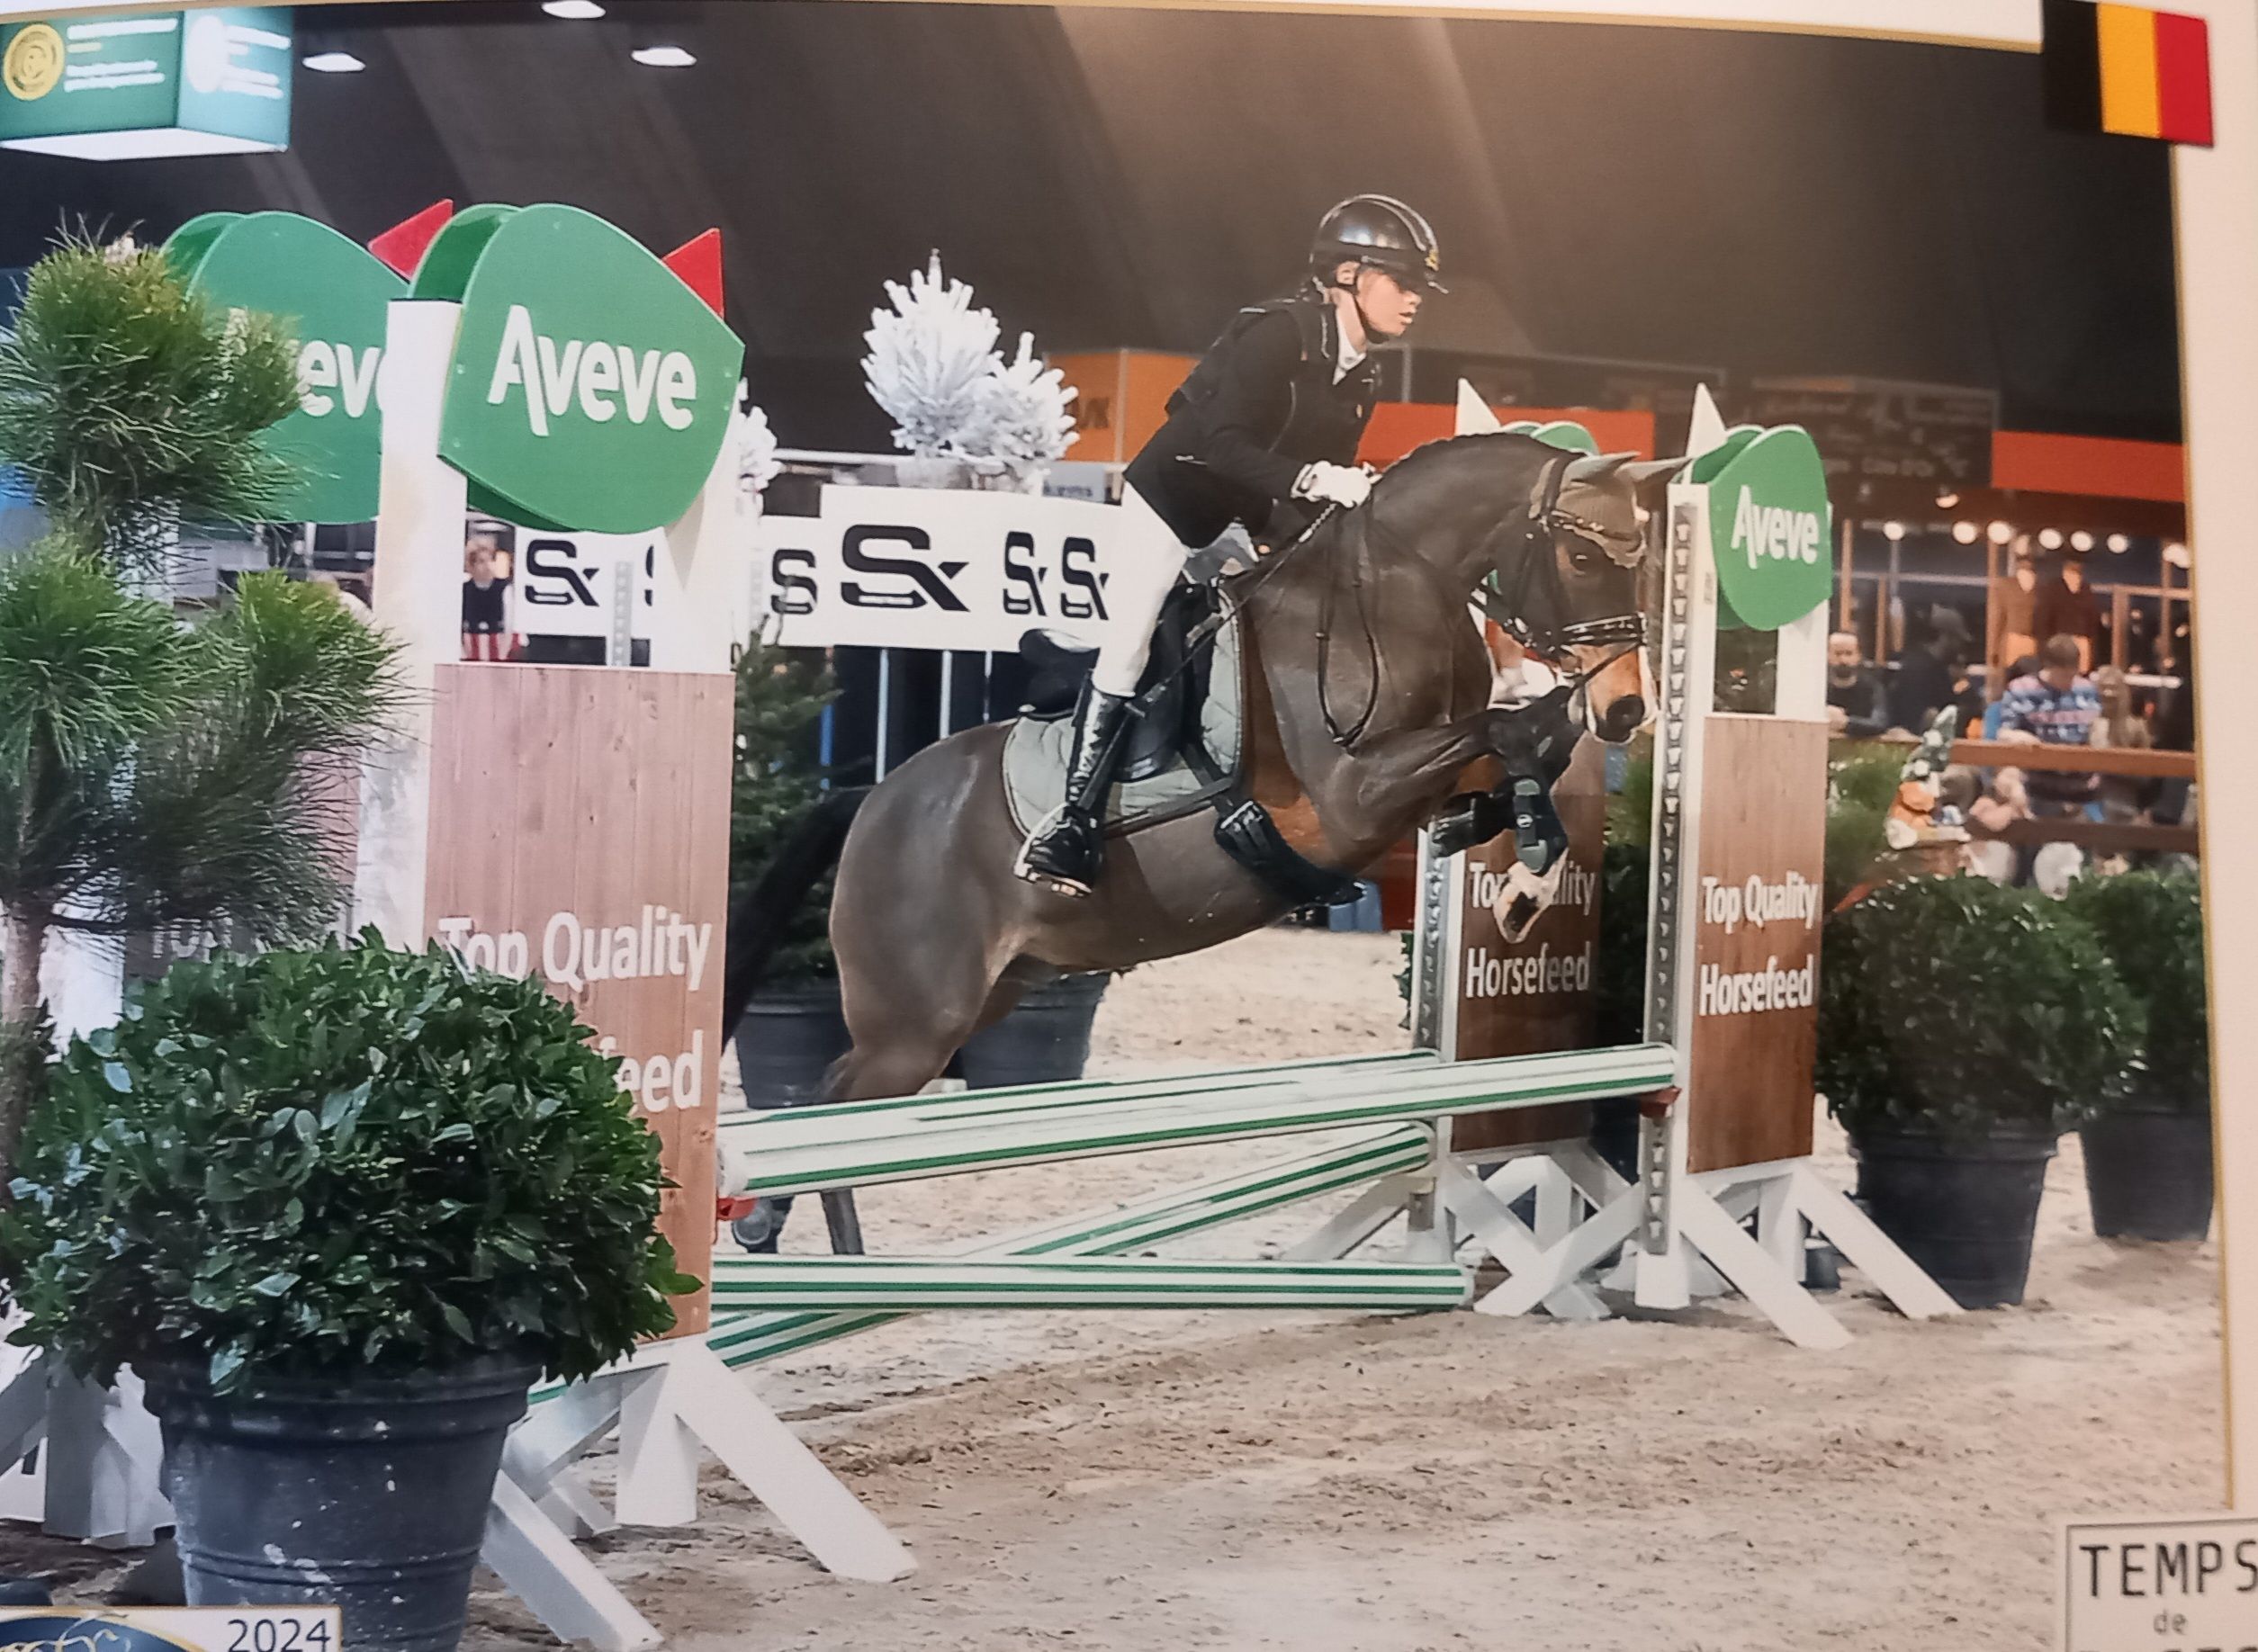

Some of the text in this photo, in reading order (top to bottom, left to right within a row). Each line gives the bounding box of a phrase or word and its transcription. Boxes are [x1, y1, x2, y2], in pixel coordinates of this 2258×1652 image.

[487, 304, 697, 437] Aveve
[1730, 484, 1820, 570] Aveve
[1703, 869, 1820, 934] Top Quality
[542, 903, 713, 992] Quality
[1465, 940, 1591, 1000] Horsefeed
[1698, 954, 1815, 1017] Horsefeed
[2079, 1539, 2258, 1597] TEMPS
[227, 1619, 331, 1652] 2024
[2153, 1609, 2188, 1635] de
